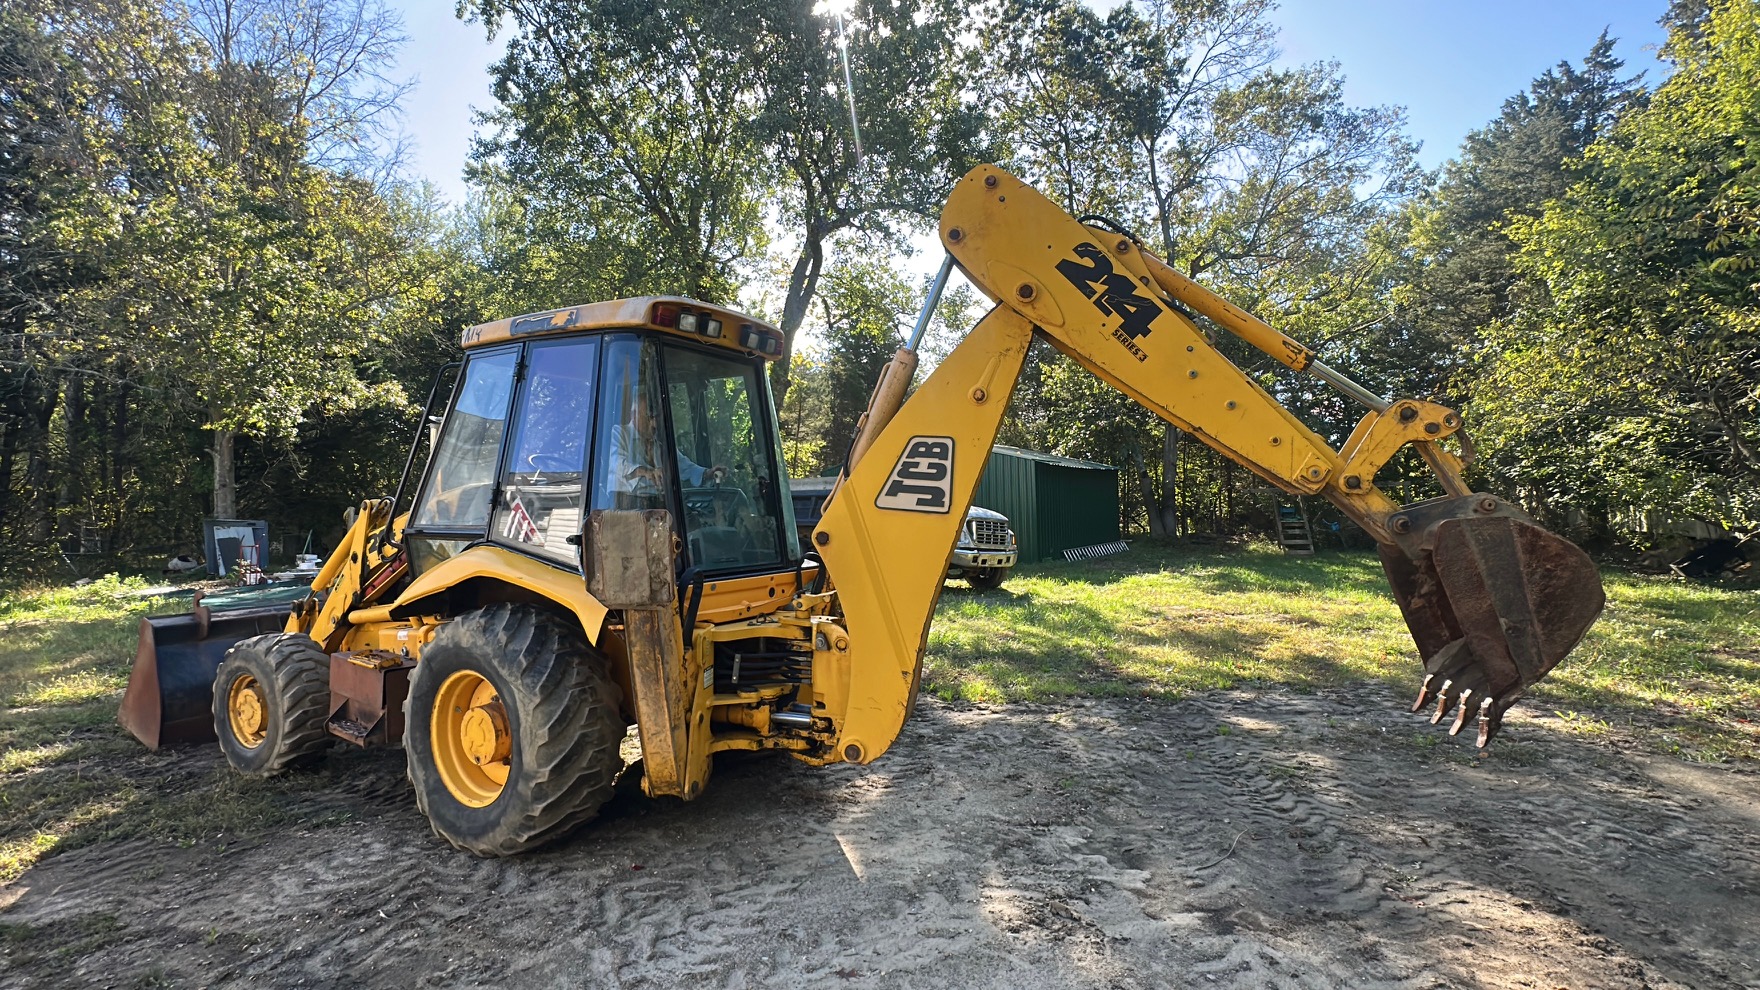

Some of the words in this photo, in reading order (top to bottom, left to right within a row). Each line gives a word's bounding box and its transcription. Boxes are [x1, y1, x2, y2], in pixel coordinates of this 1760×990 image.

[1055, 242, 1163, 340] 214
[1112, 329, 1141, 355] SERIES
[1138, 354, 1148, 362] 3
[885, 441, 949, 507] JCB
